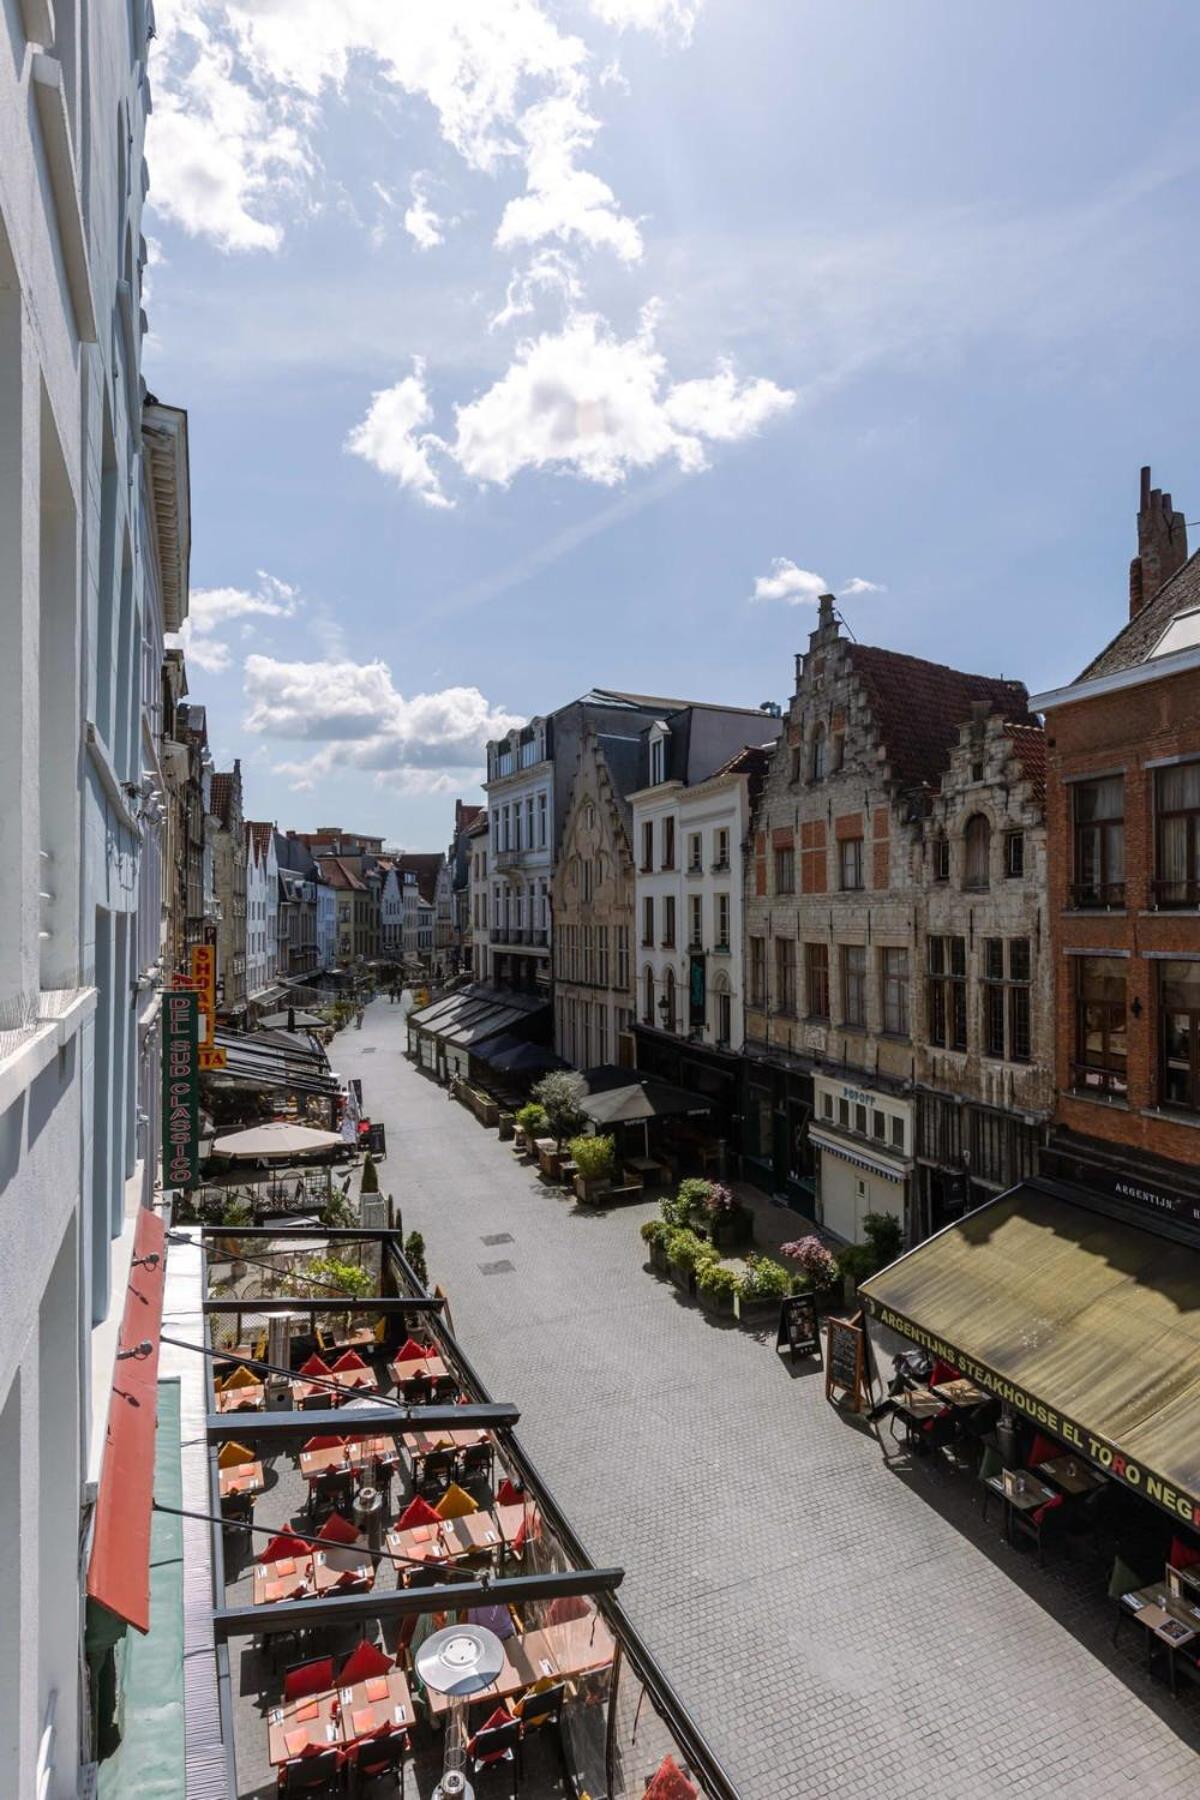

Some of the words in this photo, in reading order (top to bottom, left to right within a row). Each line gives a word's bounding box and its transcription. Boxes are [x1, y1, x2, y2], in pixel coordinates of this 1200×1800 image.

[169, 998, 191, 1034] DEL
[170, 1040, 191, 1078] SUD
[169, 1082, 192, 1182] CLASSICO
[880, 1309, 955, 1364] ARGENTIJNS
[958, 1356, 1058, 1431] STEAKHOUSE
[1062, 1421, 1083, 1448] EL
[1089, 1437, 1140, 1485] TORO
